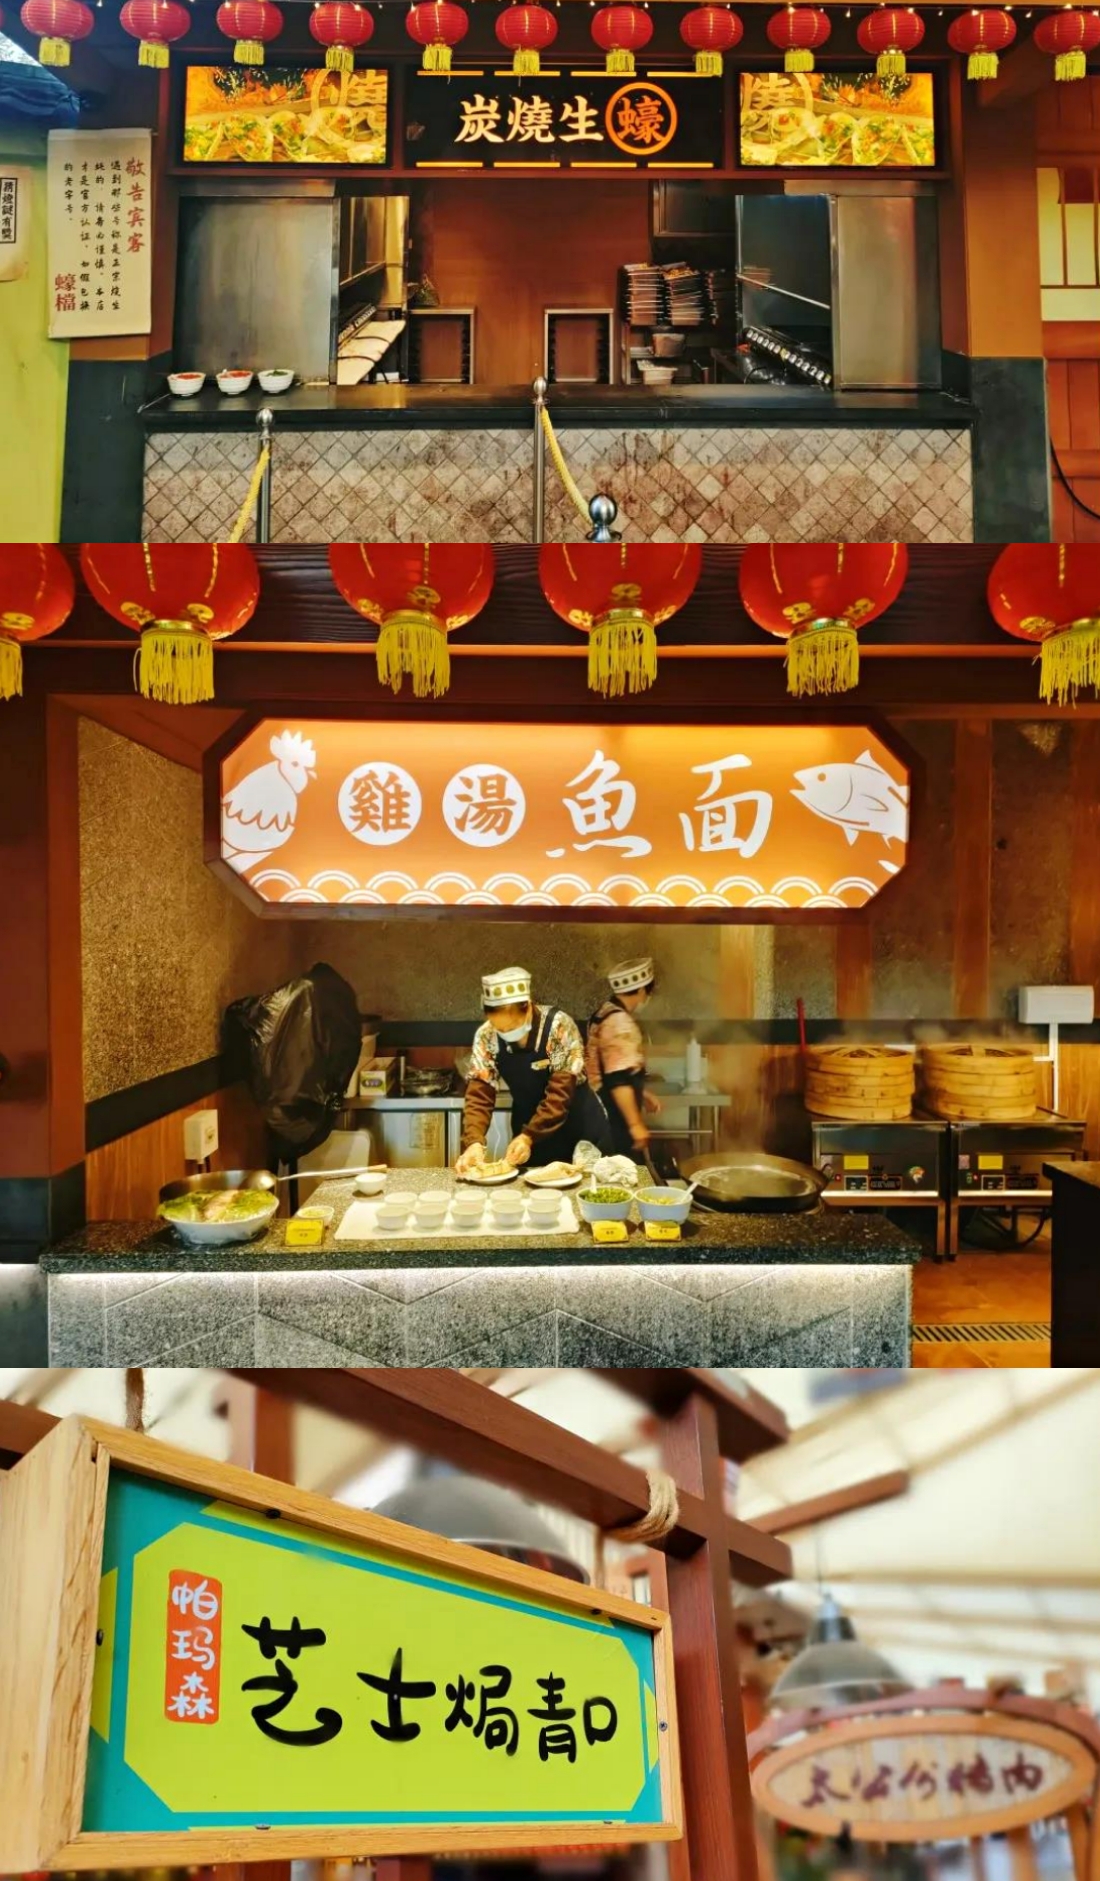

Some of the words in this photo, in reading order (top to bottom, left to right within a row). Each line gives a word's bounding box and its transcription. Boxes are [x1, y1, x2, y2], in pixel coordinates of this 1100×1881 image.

[454, 91, 670, 147] 炭燒生蠔
[345, 749, 773, 859] 雞湯魚面
[166, 1579, 219, 1719] 帕玛森
[240, 1616, 618, 1764] 芝士焗青口
